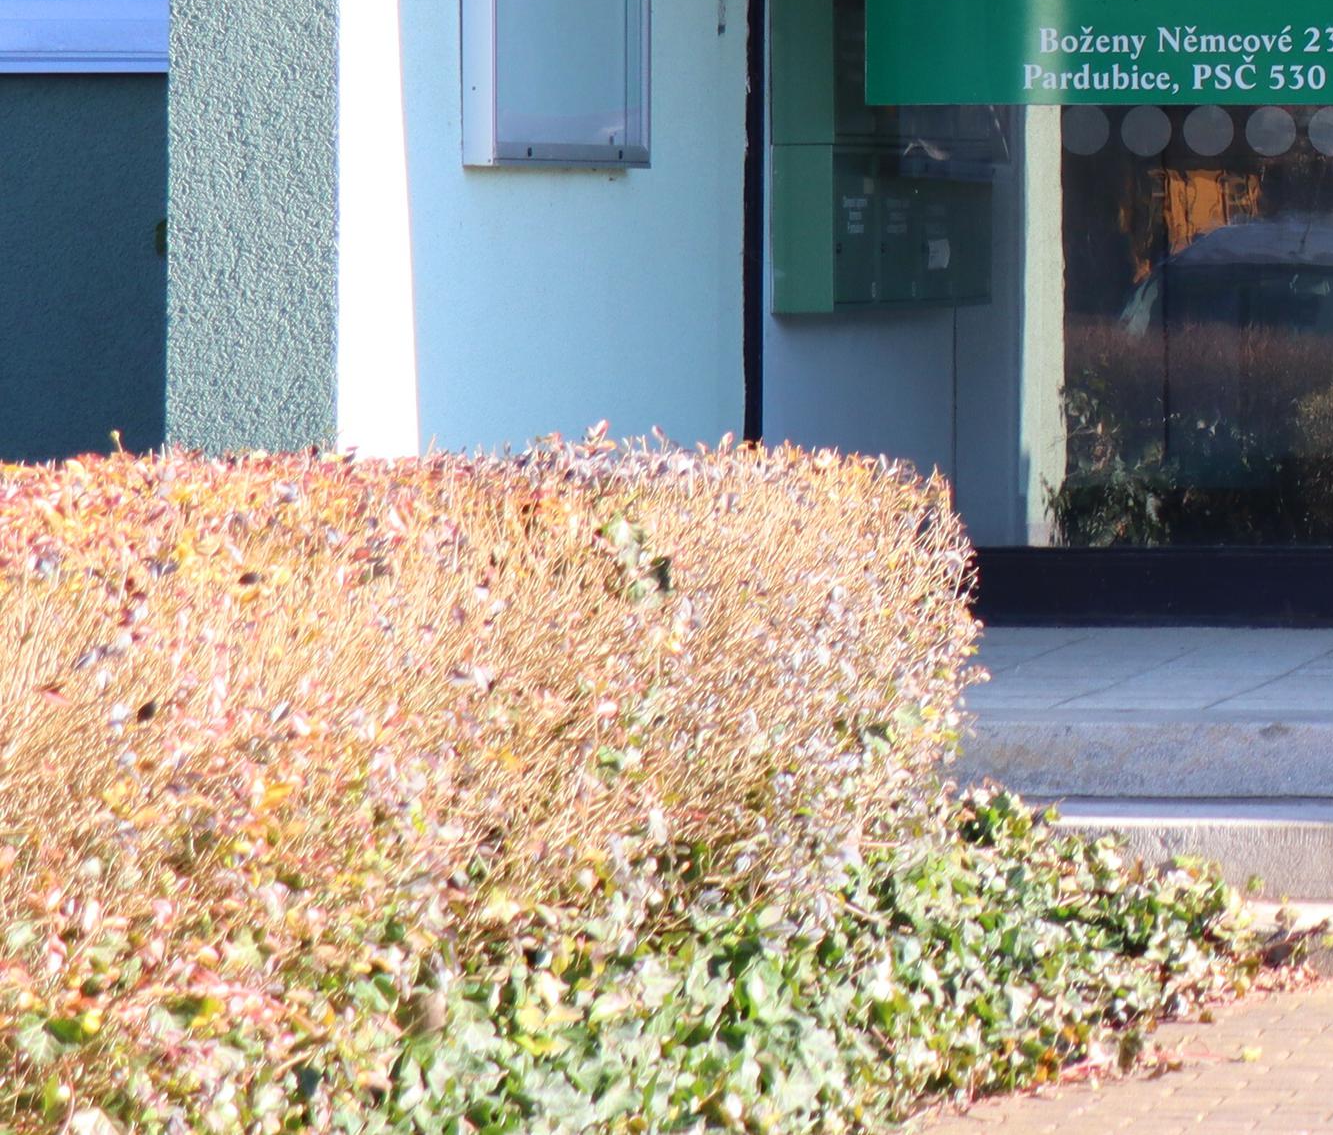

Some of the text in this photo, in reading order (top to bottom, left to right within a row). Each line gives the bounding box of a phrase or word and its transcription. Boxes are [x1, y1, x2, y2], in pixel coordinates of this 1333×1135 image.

[1039, 26, 1146, 59] Boženy
[1157, 25, 1292, 53] Němcové
[1023, 64, 1180, 94] Pardubice,
[1192, 55, 1257, 90] PSČ
[1269, 65, 1326, 90] 530
